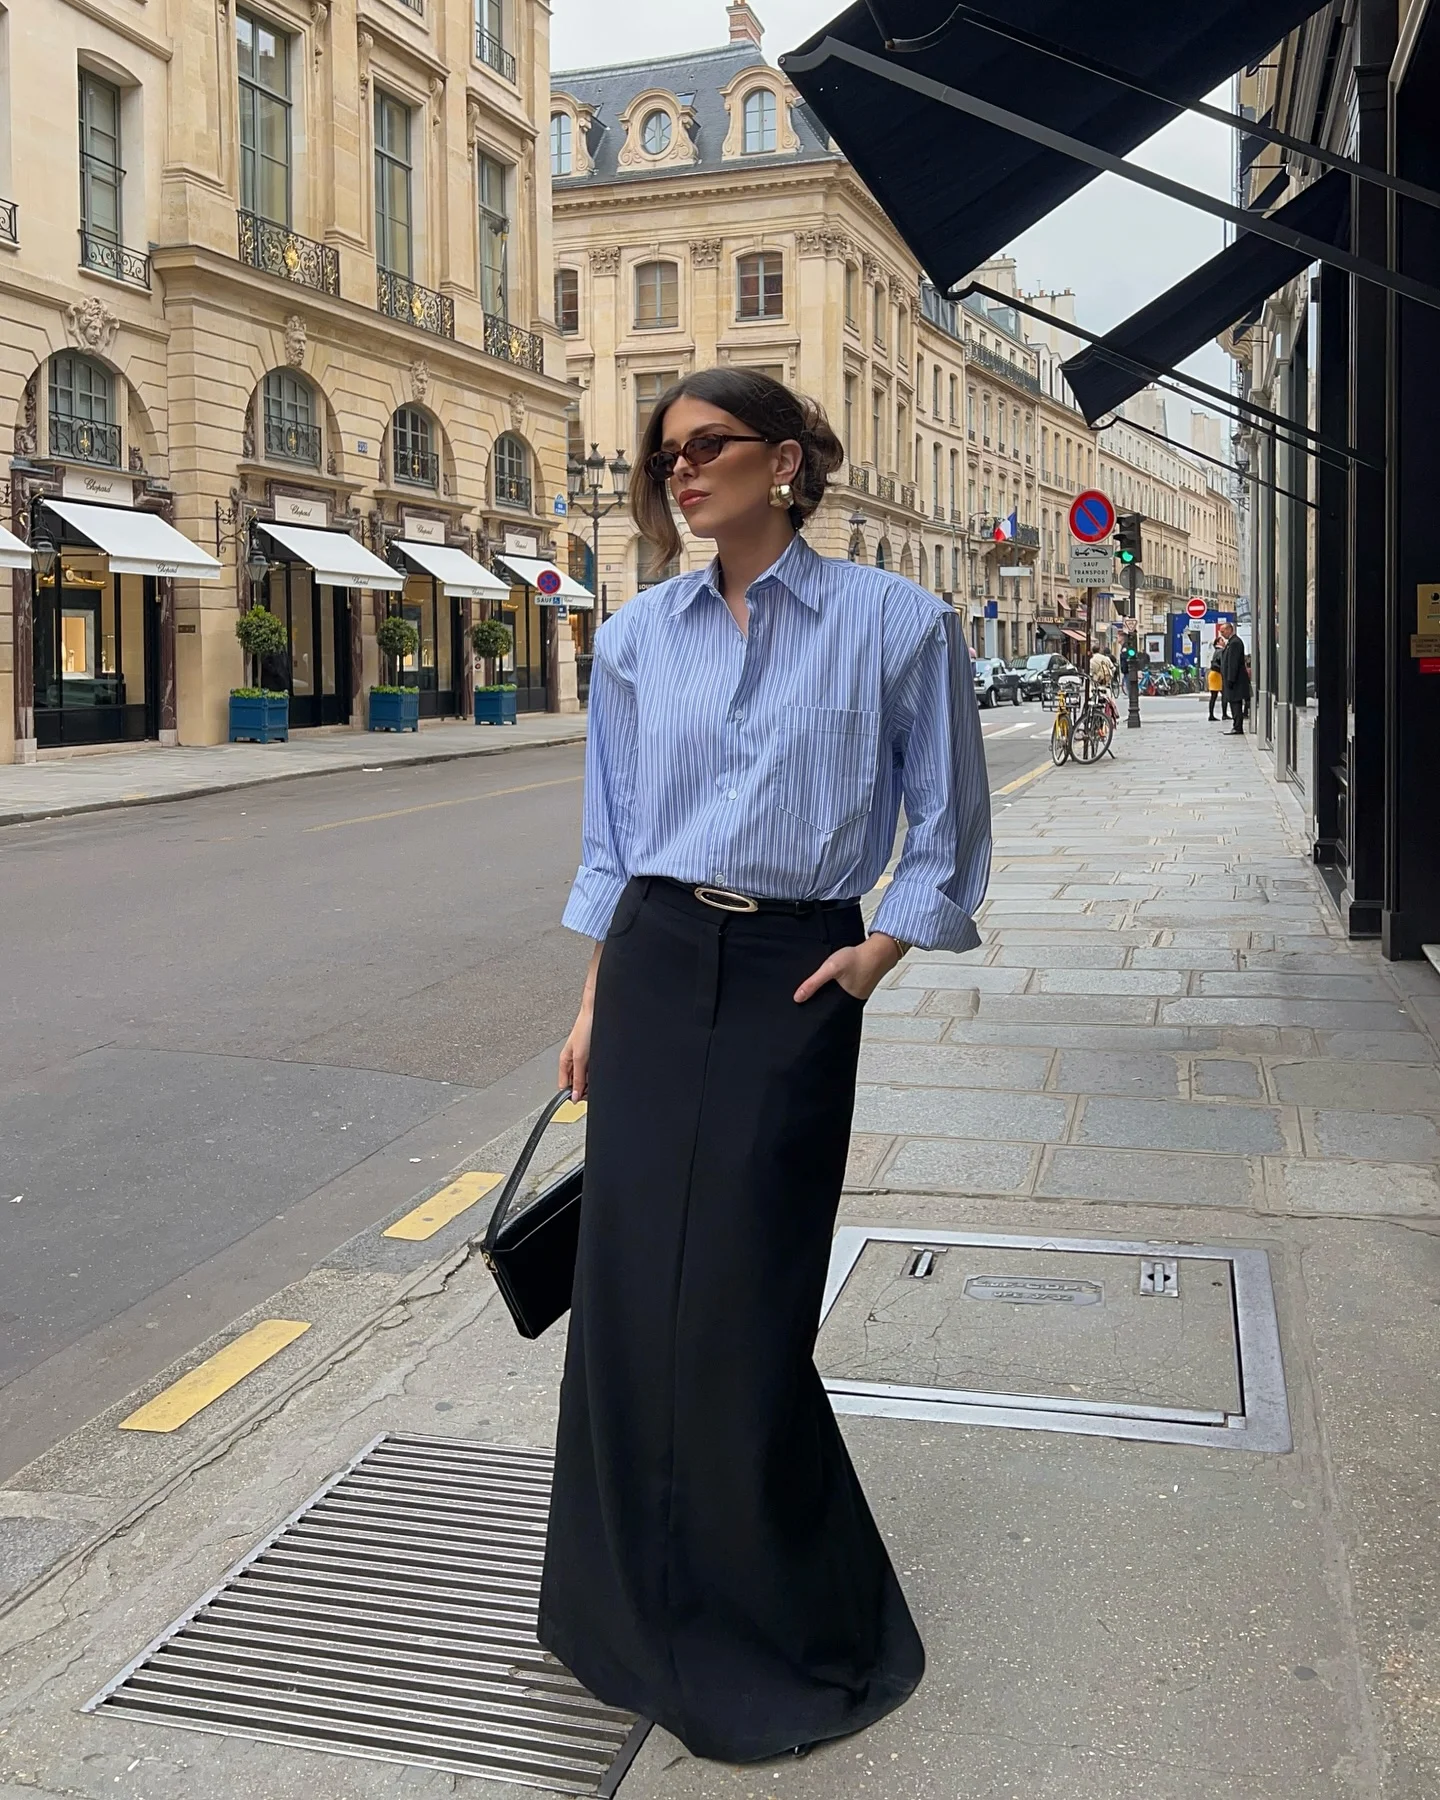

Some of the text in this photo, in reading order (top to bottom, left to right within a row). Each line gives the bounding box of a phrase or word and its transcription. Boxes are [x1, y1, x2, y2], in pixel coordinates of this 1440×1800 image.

[84, 477, 113, 494] Chopard
[290, 503, 312, 518] Chopard
[156, 561, 179, 575] Chopard
